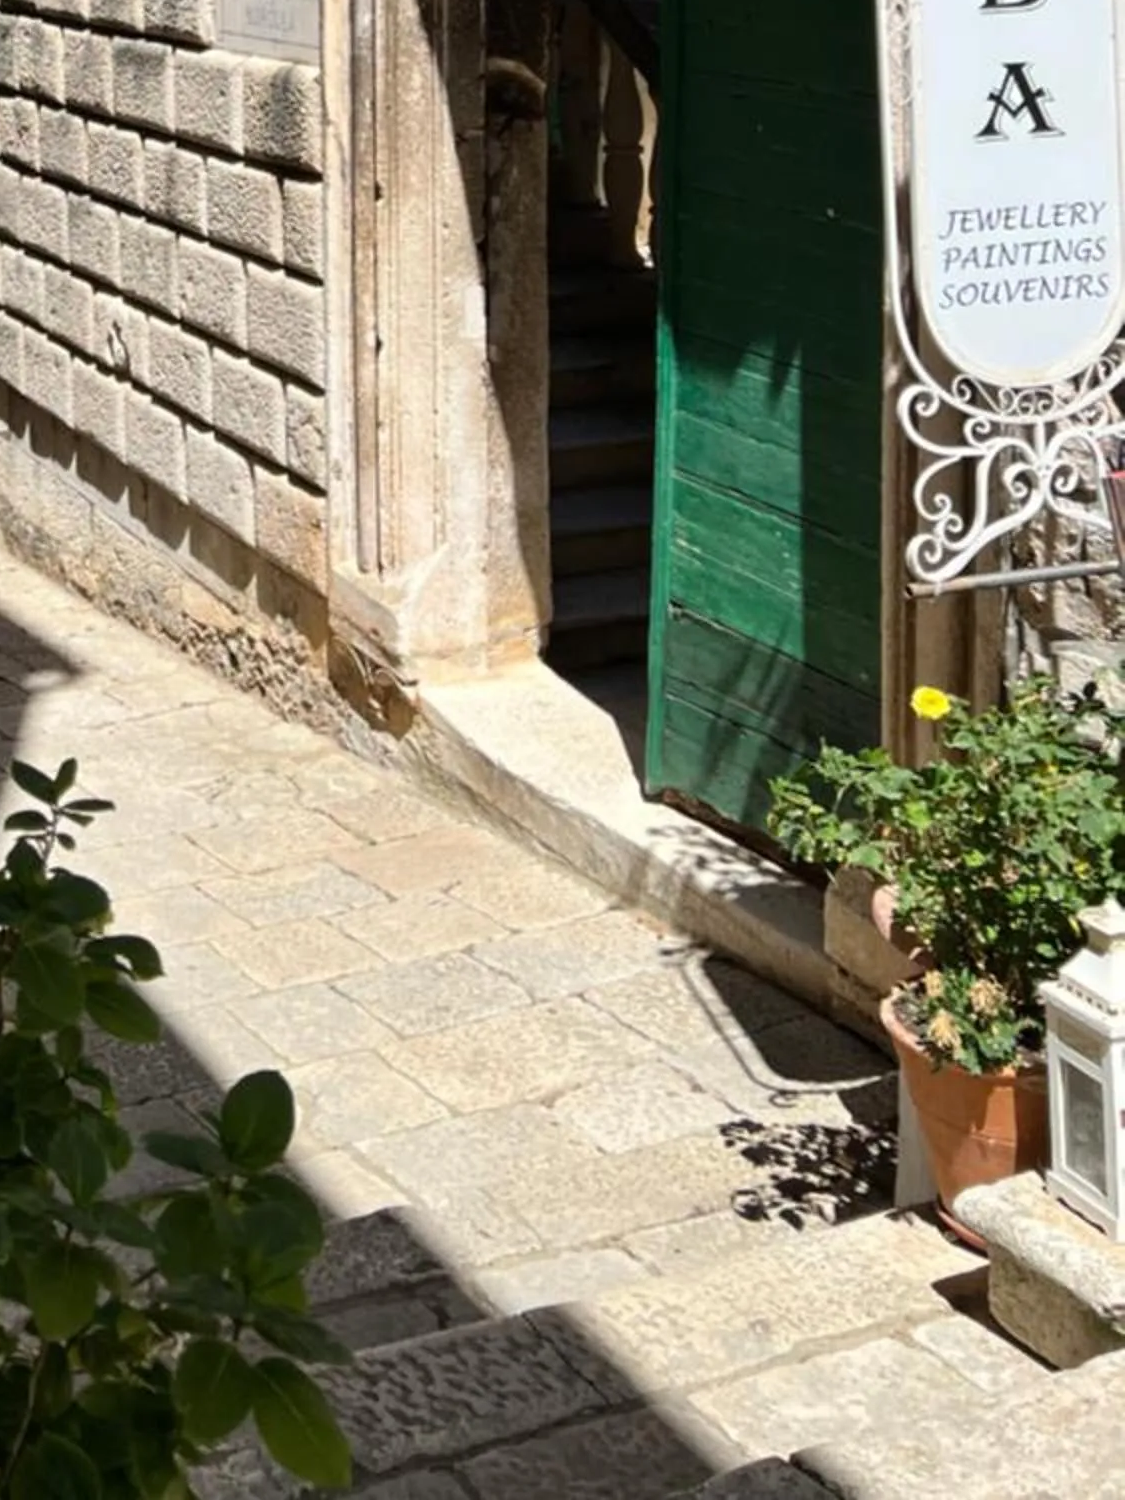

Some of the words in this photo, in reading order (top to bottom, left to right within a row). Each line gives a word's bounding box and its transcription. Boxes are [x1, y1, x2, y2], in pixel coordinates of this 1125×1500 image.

[938, 201, 1106, 240] JEWELLERY
[942, 236, 1106, 273] PAINTINGS
[938, 273, 1110, 309] SOUVENIRS
